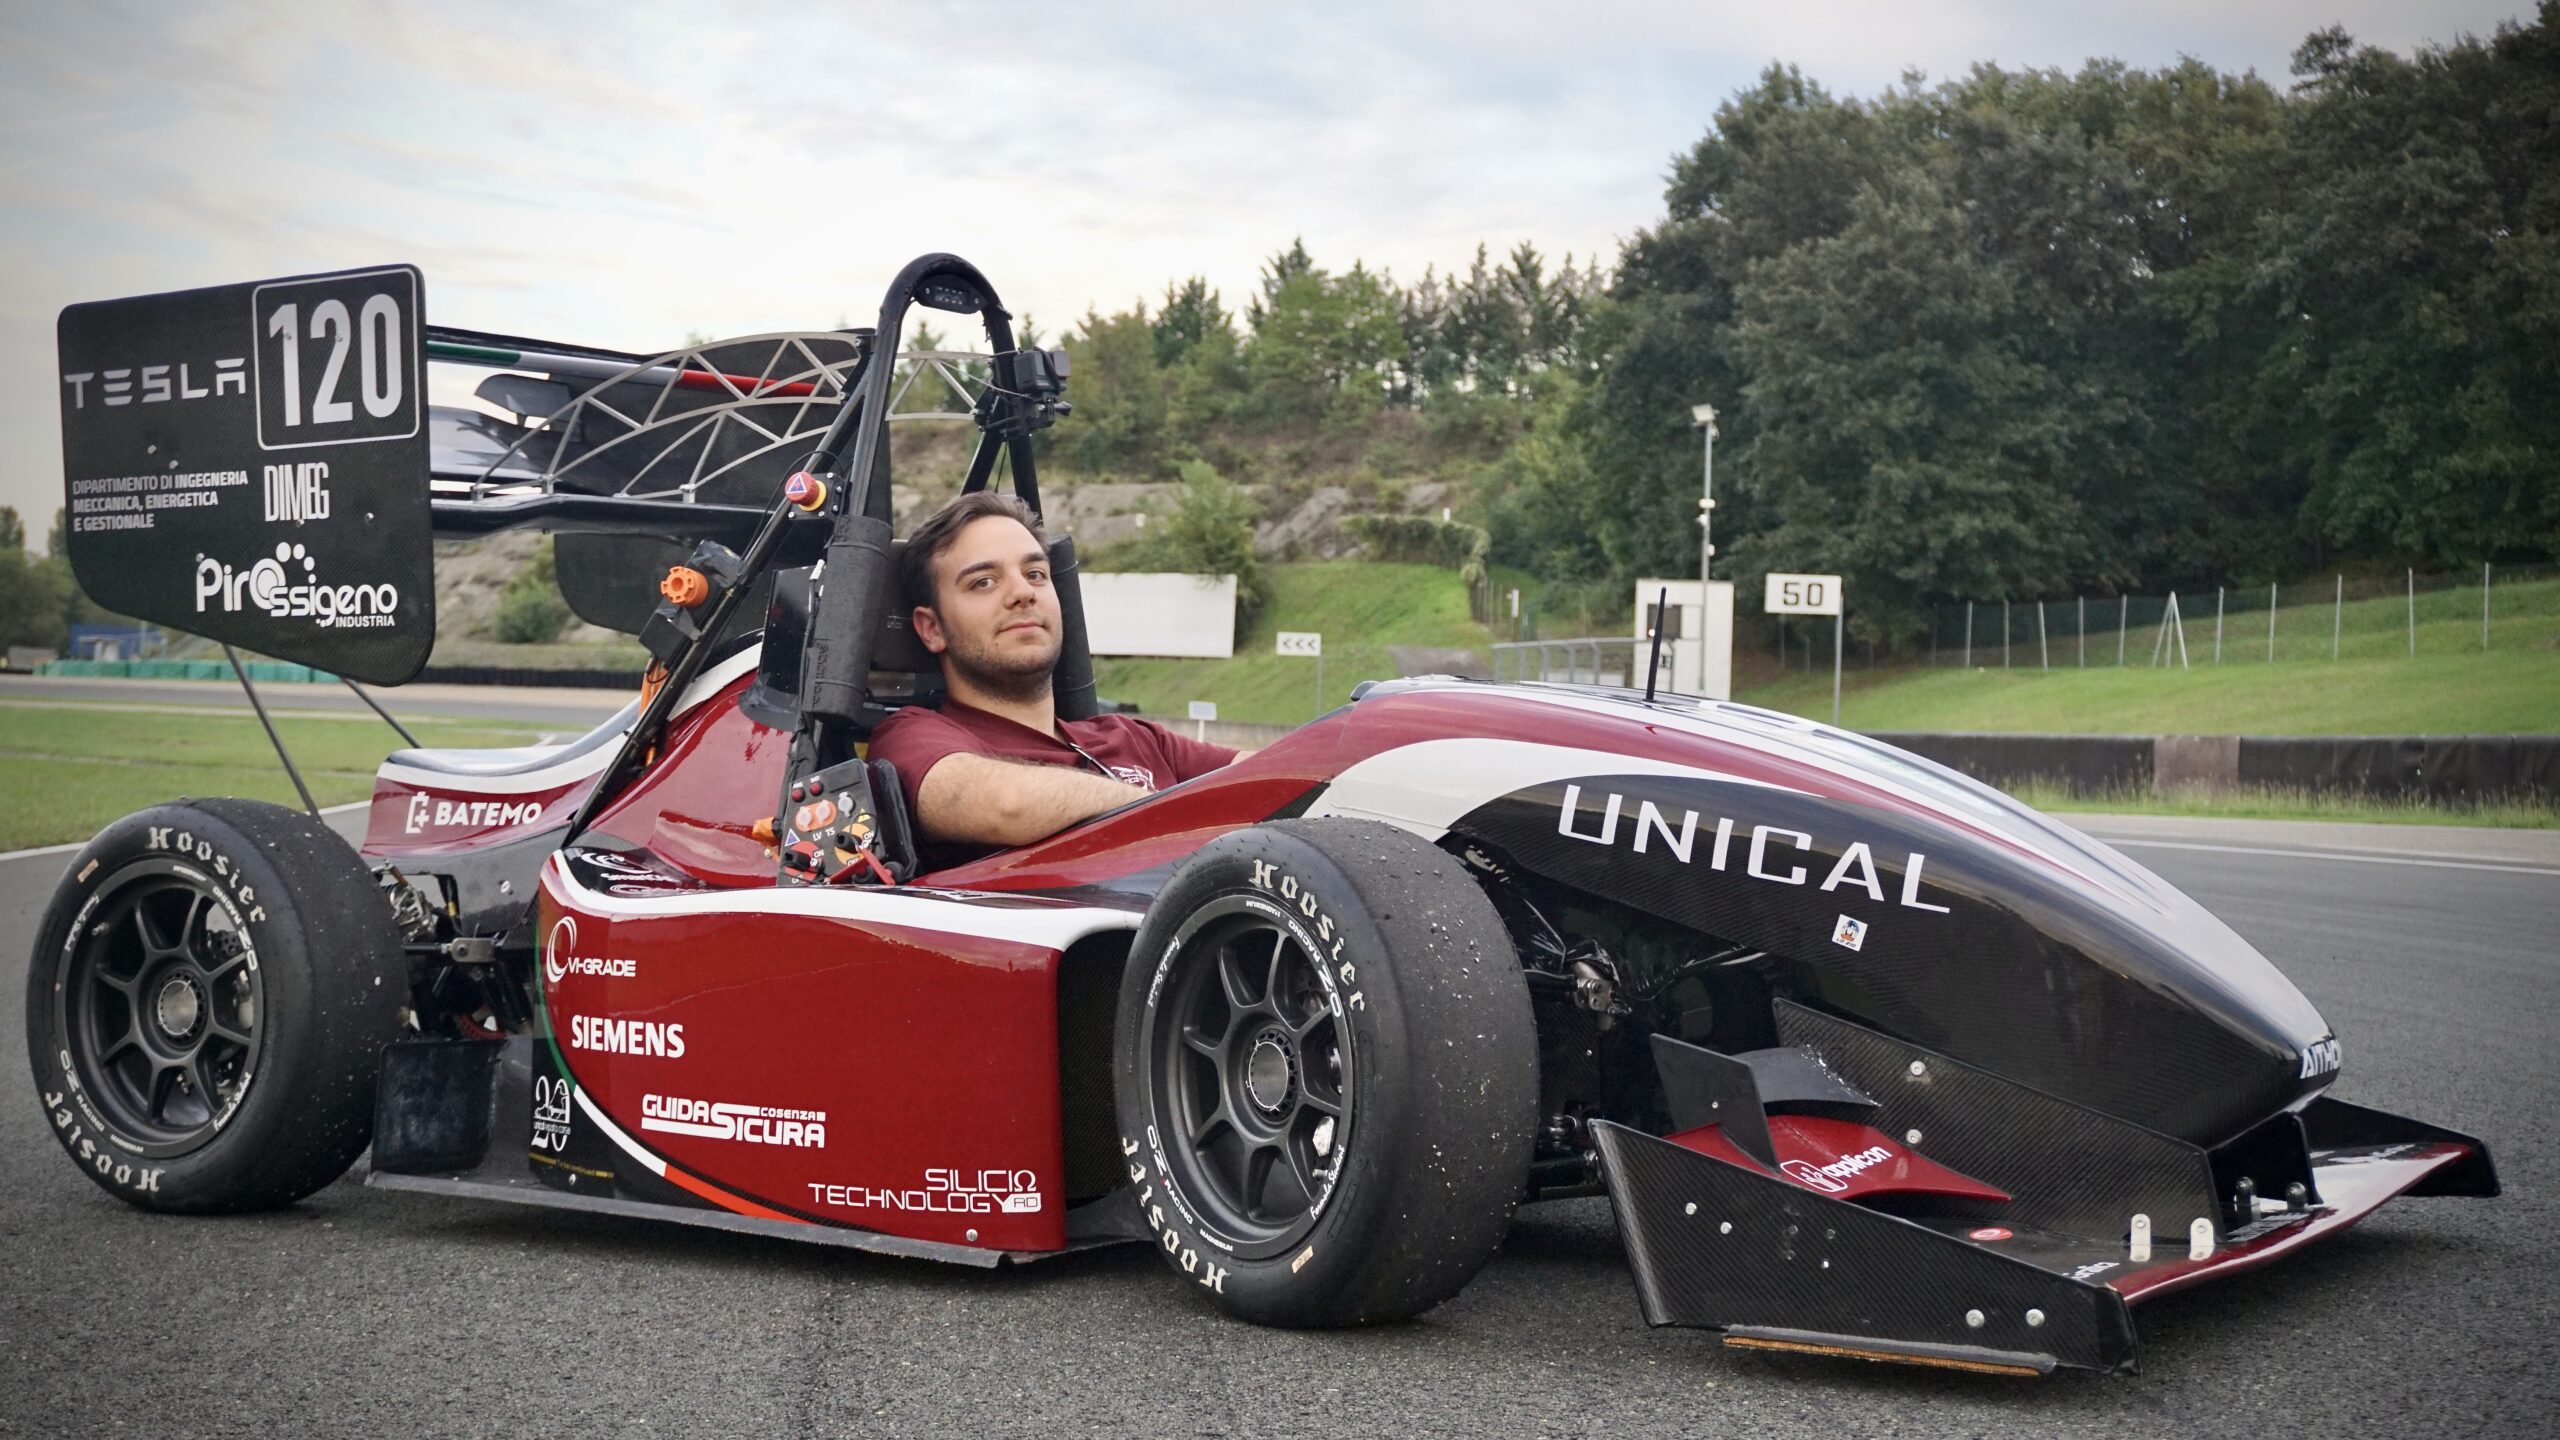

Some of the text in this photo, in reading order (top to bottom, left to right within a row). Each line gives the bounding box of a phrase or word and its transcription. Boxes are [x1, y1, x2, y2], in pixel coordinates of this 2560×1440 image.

[269, 293, 402, 427] 120
[64, 357, 246, 409] TESLA
[73, 470, 248, 495] DIPARTIMENTO DI INGEGNERIA
[145, 491, 219, 510] ENERGETICA
[264, 462, 330, 522] DIMEG
[74, 514, 155, 532] E GESTIONALE
[1783, 582, 1823, 606] 50
[335, 615, 395, 628] INDUSTRIA
[434, 802, 542, 826] BATEMO
[1558, 784, 1950, 914] UNICAL
[145, 826, 266, 923] Hoosier
[1249, 858, 1366, 1011] Hoosier
[1287, 919, 1321, 963] RACING
[567, 956, 636, 977] VI-GRADE
[571, 1014, 685, 1058] SIEMENS
[642, 1093, 710, 1124] GUIDA
[760, 1107, 816, 1121] COSENZA
[45, 1091, 166, 1192] Hoosier
[1821, 1146, 1893, 1178] applicon
[808, 1183, 1010, 1213] TECHNOLOGY
[1122, 1137, 1232, 1294] Hoosier
[1164, 1178, 1193, 1225] RACING
